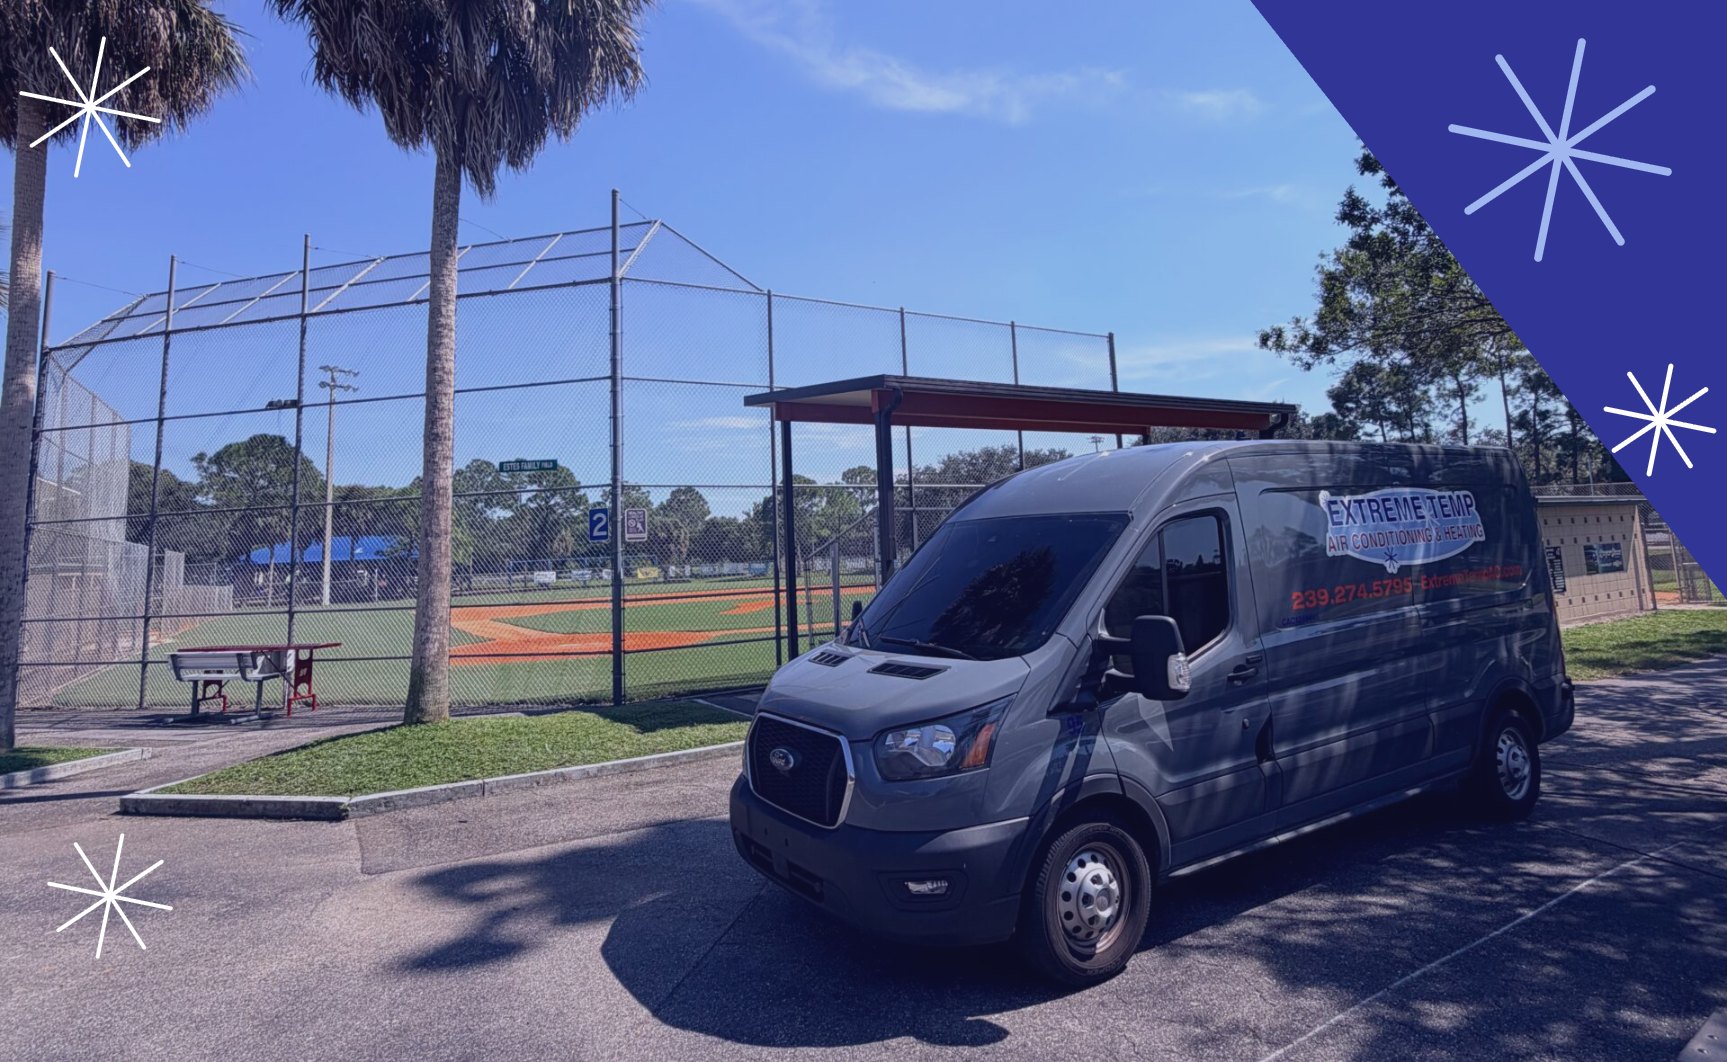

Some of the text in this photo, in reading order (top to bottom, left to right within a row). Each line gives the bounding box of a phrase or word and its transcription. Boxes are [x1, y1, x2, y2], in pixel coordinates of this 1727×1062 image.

[503, 463, 520, 471] ESTES
[520, 461, 540, 470] FAMILY
[593, 513, 607, 536] 2
[1327, 494, 1474, 526] EXTREME TEMP
[1328, 523, 1484, 552] AIR CONDITIONING & HEATING
[1291, 576, 1413, 610] 239.274.5795
